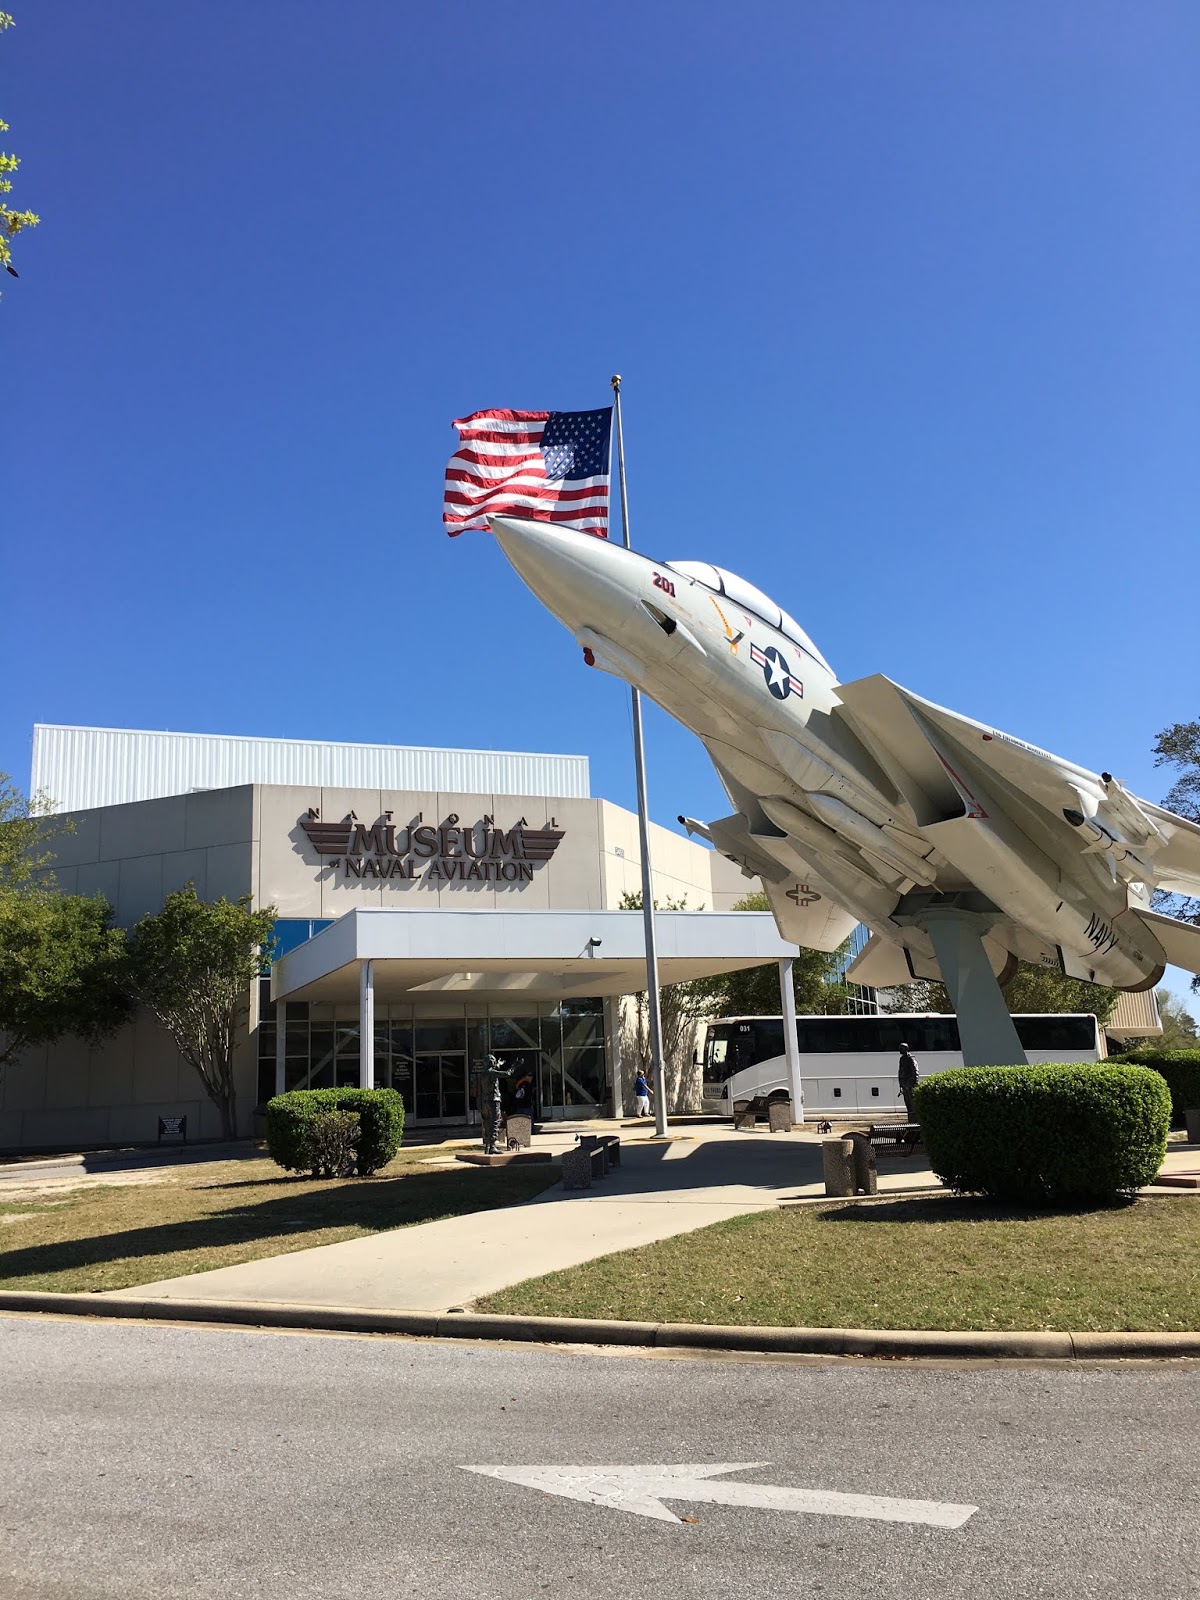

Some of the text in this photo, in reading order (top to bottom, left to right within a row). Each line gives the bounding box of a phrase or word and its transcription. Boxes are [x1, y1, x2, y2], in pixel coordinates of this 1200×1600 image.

[652, 571, 676, 598] 201
[308, 807, 559, 828] NATIONAL
[350, 823, 524, 860] MUSEUM
[329, 858, 534, 881] of NAVAL AVIATION
[1084, 912, 1120, 955] NAVY
